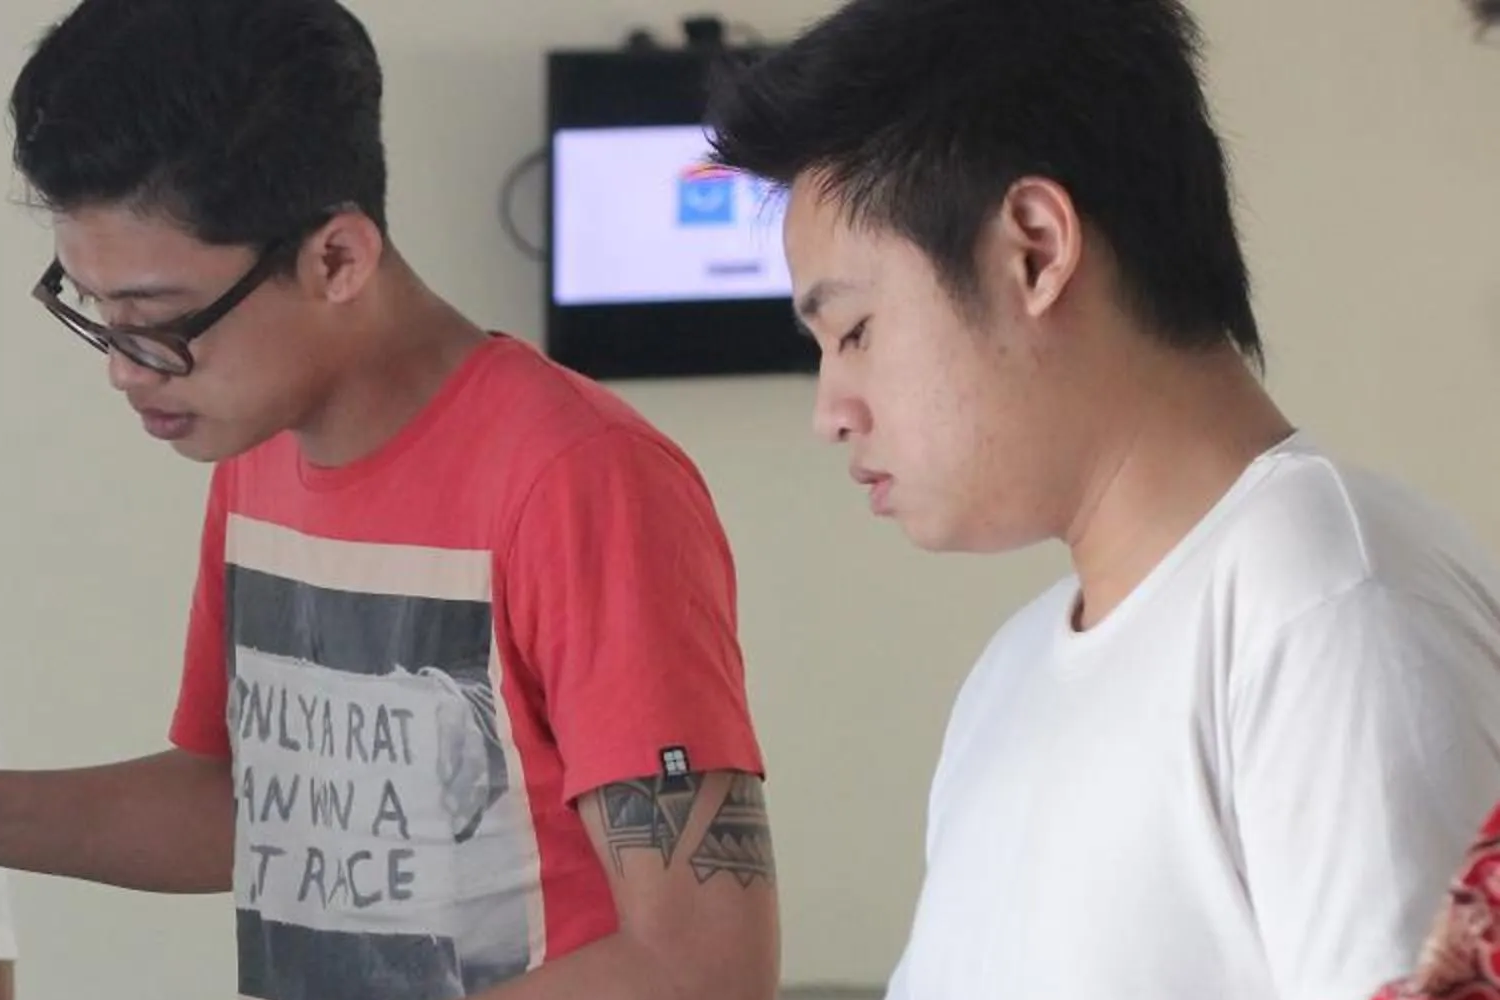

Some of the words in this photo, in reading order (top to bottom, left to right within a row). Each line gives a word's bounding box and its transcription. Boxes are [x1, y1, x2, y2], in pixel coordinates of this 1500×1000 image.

[345, 701, 414, 766] RAT
[371, 779, 411, 841] A
[250, 844, 288, 904] T
[297, 846, 416, 909] RACE
